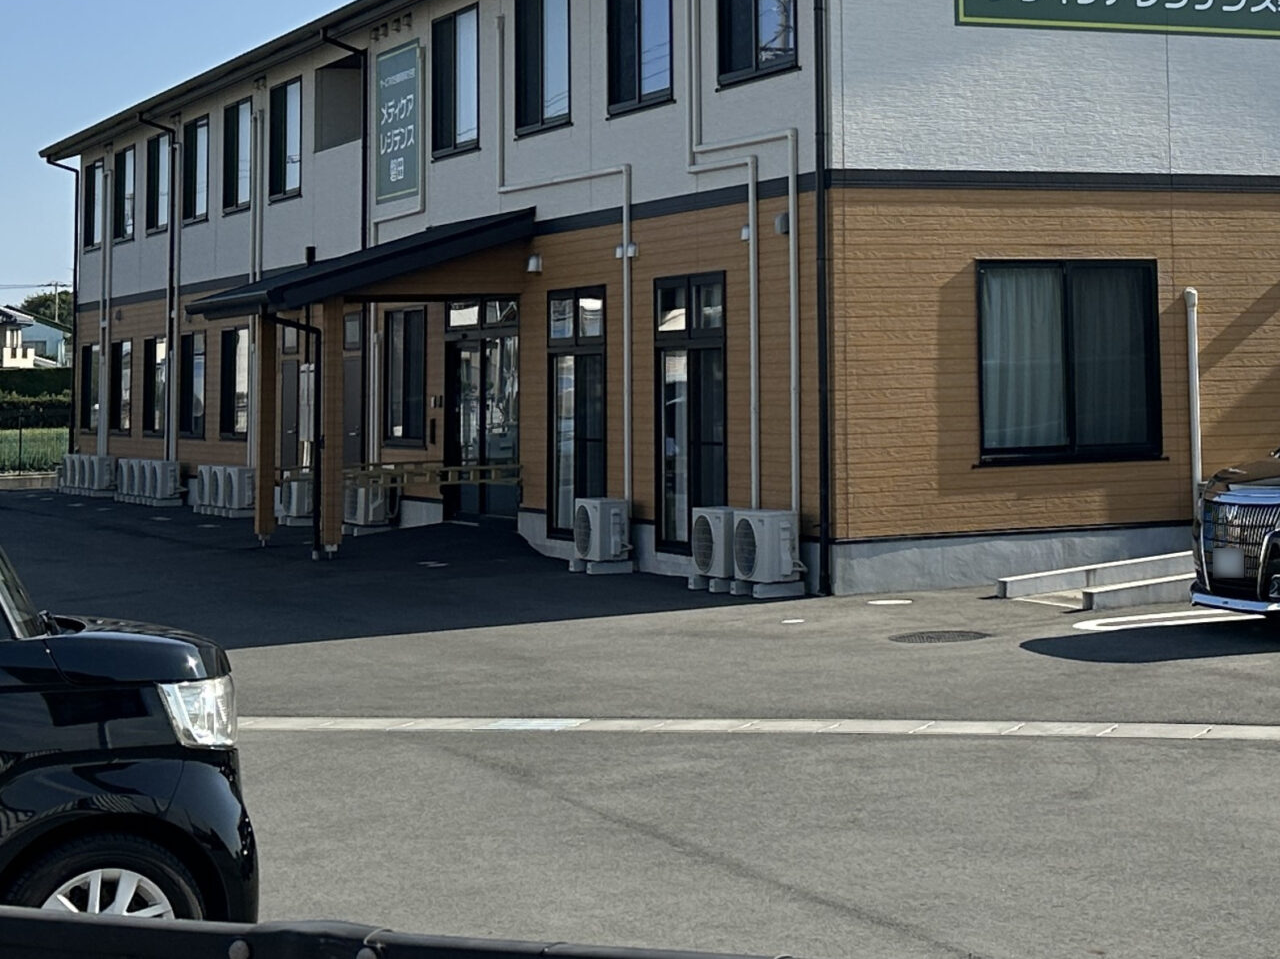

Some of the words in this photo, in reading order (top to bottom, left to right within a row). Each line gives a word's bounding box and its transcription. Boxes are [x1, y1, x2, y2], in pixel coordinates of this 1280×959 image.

[380, 94, 414, 126] メディケア
